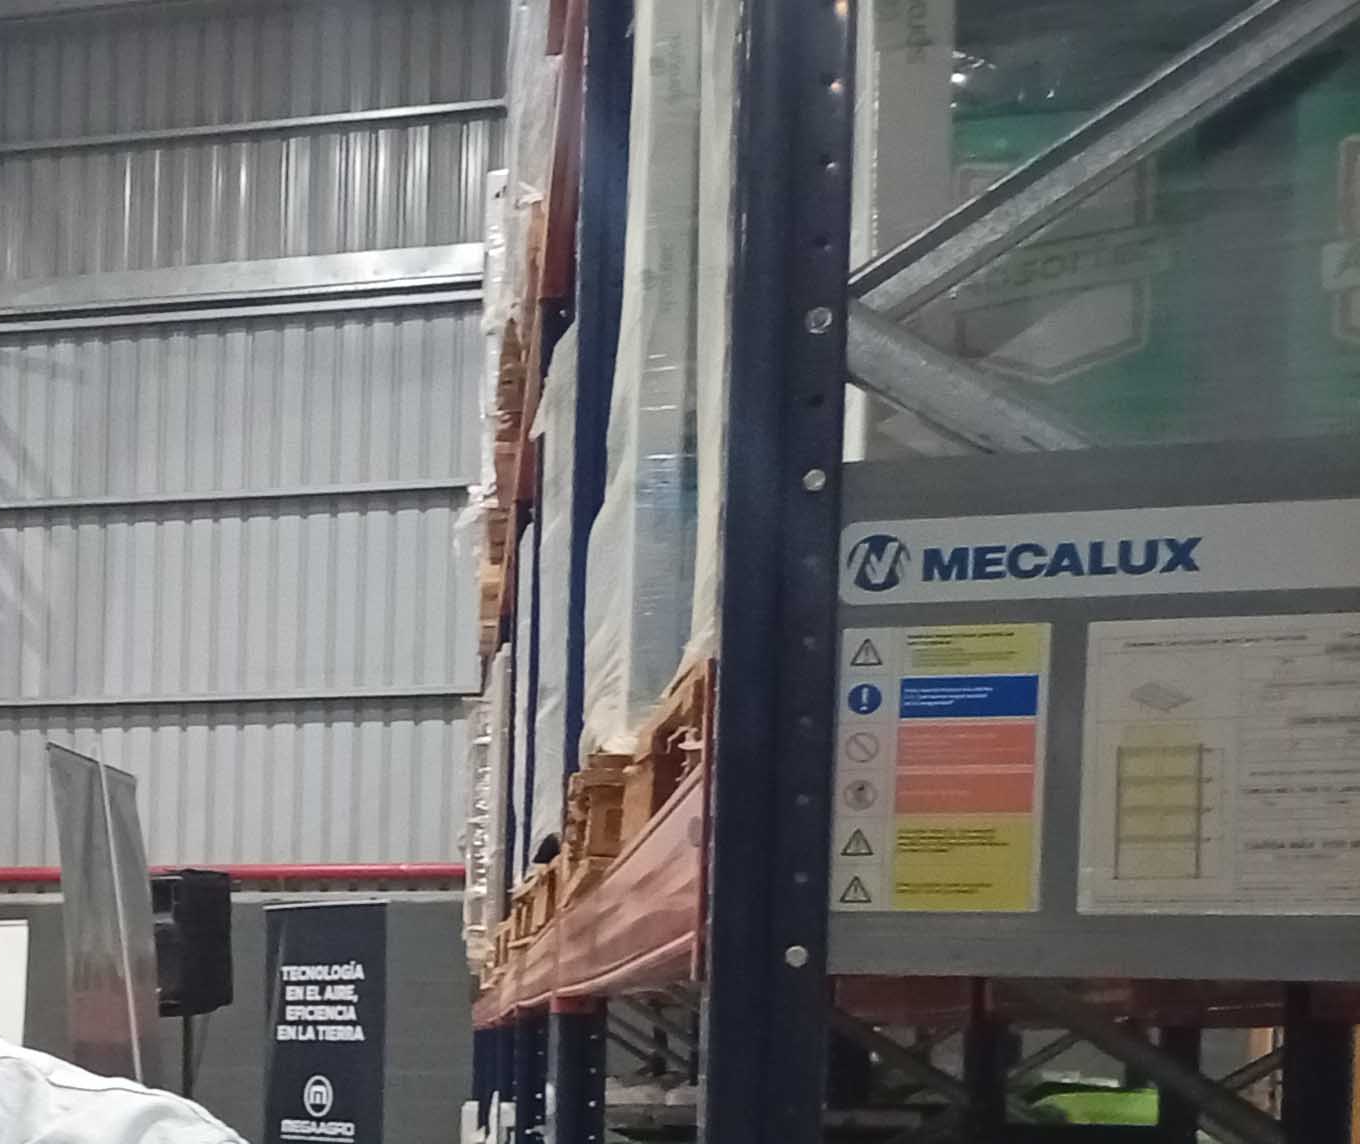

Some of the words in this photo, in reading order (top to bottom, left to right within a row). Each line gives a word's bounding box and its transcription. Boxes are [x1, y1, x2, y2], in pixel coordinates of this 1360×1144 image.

[922, 537, 1203, 582] MECALUX
[280, 960, 366, 981] TECNOLOGÍA
[285, 985, 304, 1001] EN
[305, 985, 322, 1001] EL
[285, 1005, 357, 1021] EFICIENCIA
[277, 1025, 297, 1041] EN
[298, 1025, 316, 1041] LA
[316, 1025, 366, 1042] TIERRA
